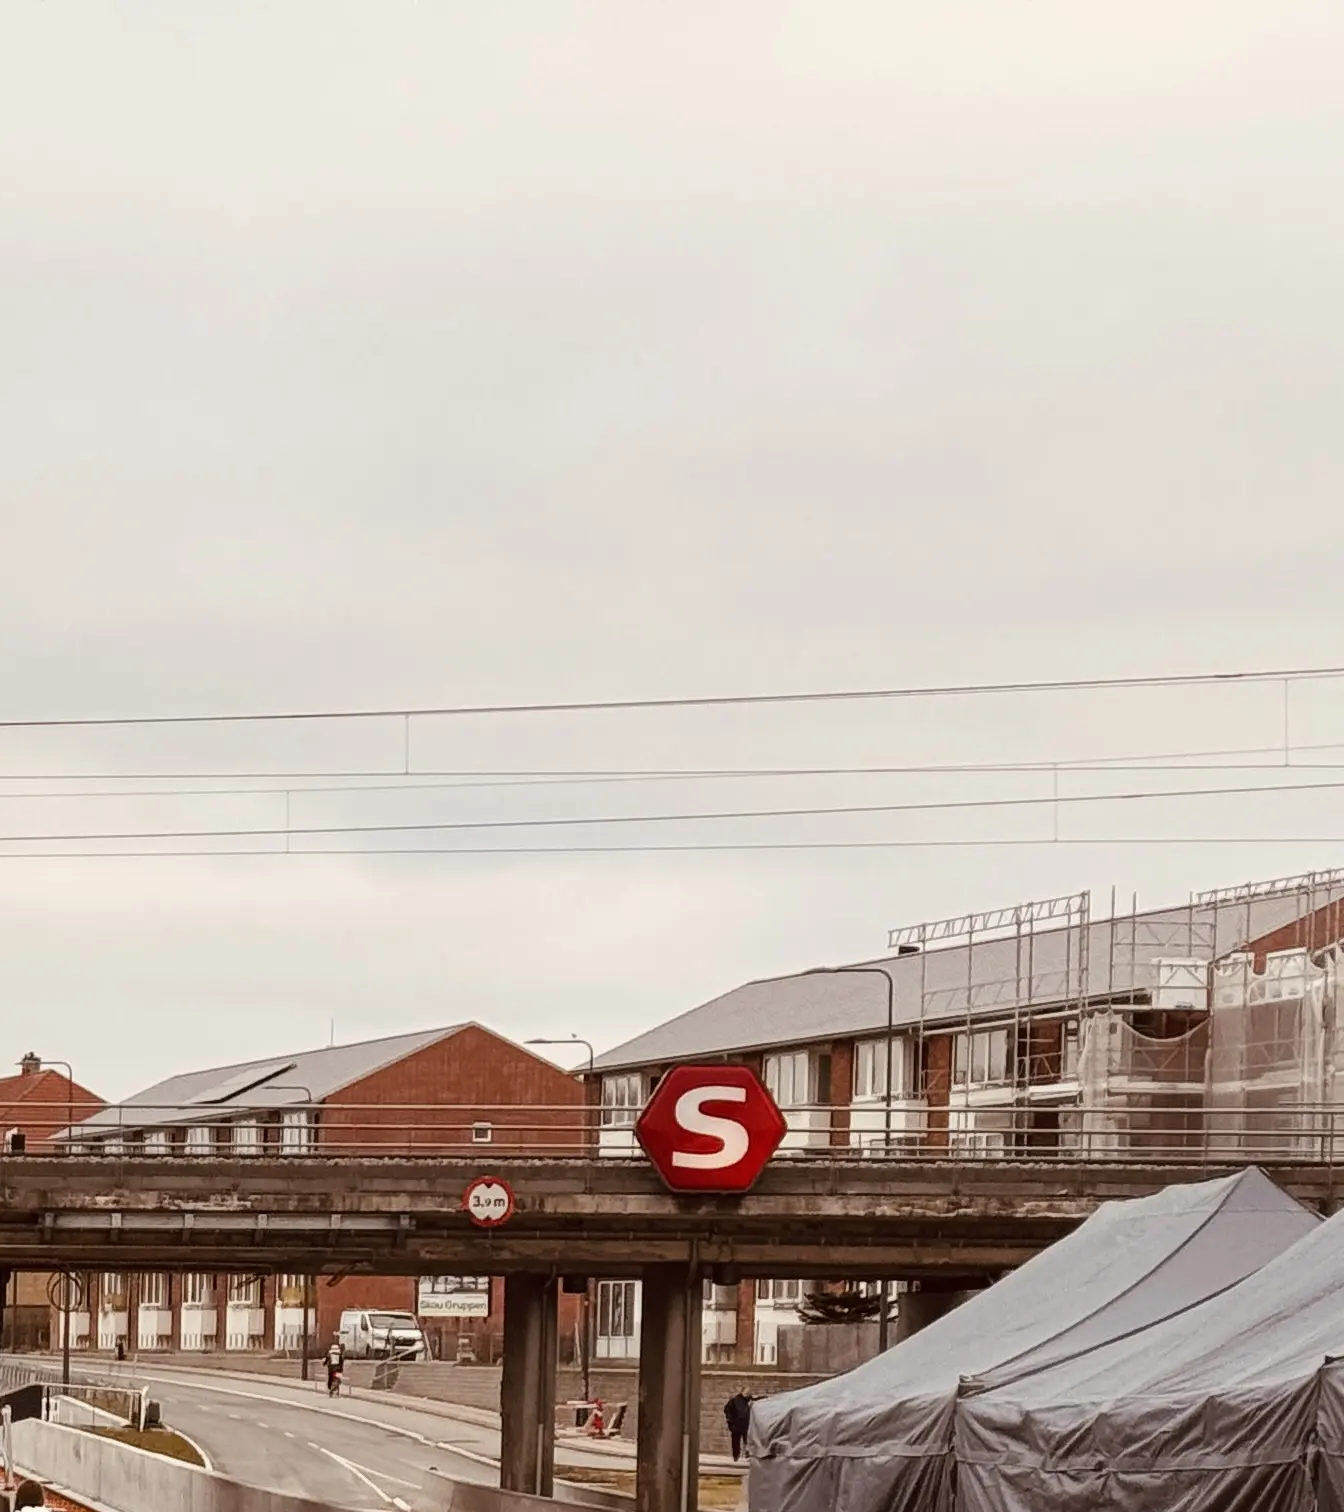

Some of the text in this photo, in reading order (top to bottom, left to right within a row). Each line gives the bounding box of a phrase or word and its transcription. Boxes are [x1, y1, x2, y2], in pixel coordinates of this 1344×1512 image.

[672, 1085, 749, 1170] S
[472, 1195, 506, 1208] 3,9 m
